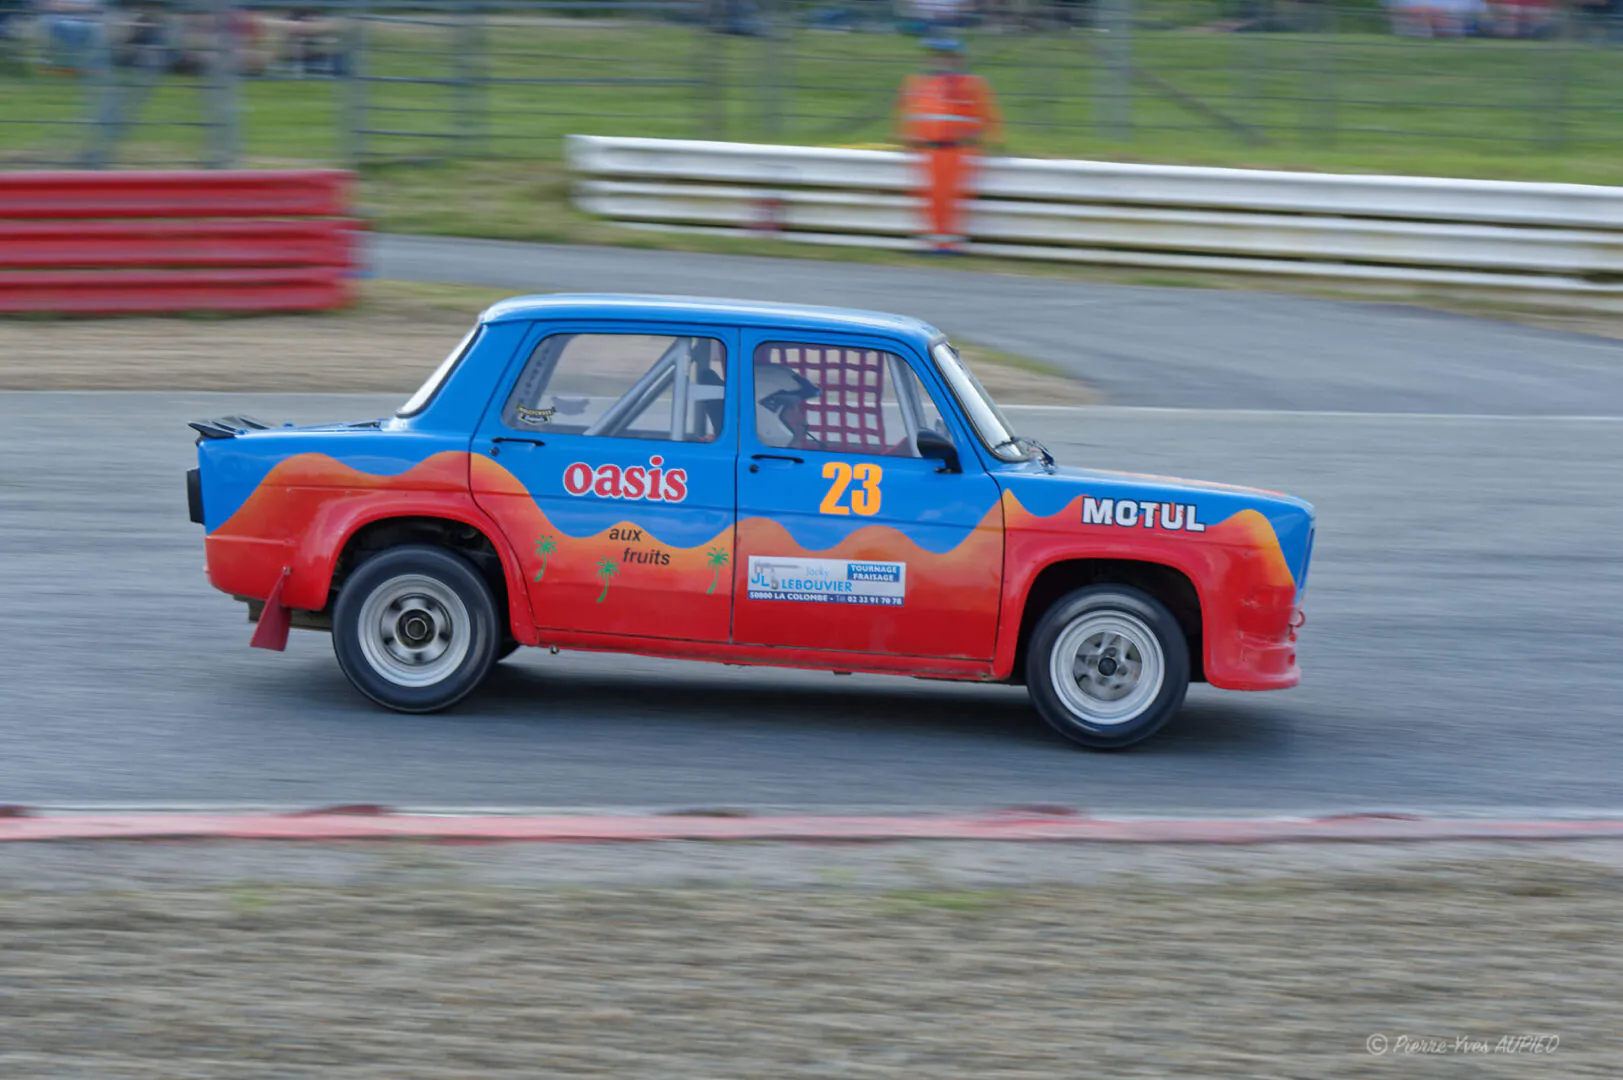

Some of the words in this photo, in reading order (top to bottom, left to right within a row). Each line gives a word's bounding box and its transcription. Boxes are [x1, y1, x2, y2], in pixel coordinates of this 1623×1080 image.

[563, 455, 688, 503] oasis
[819, 462, 883, 516] 23
[1081, 496, 1207, 533] MOTUL
[608, 528, 643, 543] aux
[622, 548, 671, 566] fruits
[850, 564, 897, 574] TOURNAGE
[852, 573, 894, 582] FRAISAGE
[781, 578, 853, 593] LEBOUVIER
[774, 592, 786, 601] LA
[786, 592, 829, 602] COLOMBE
